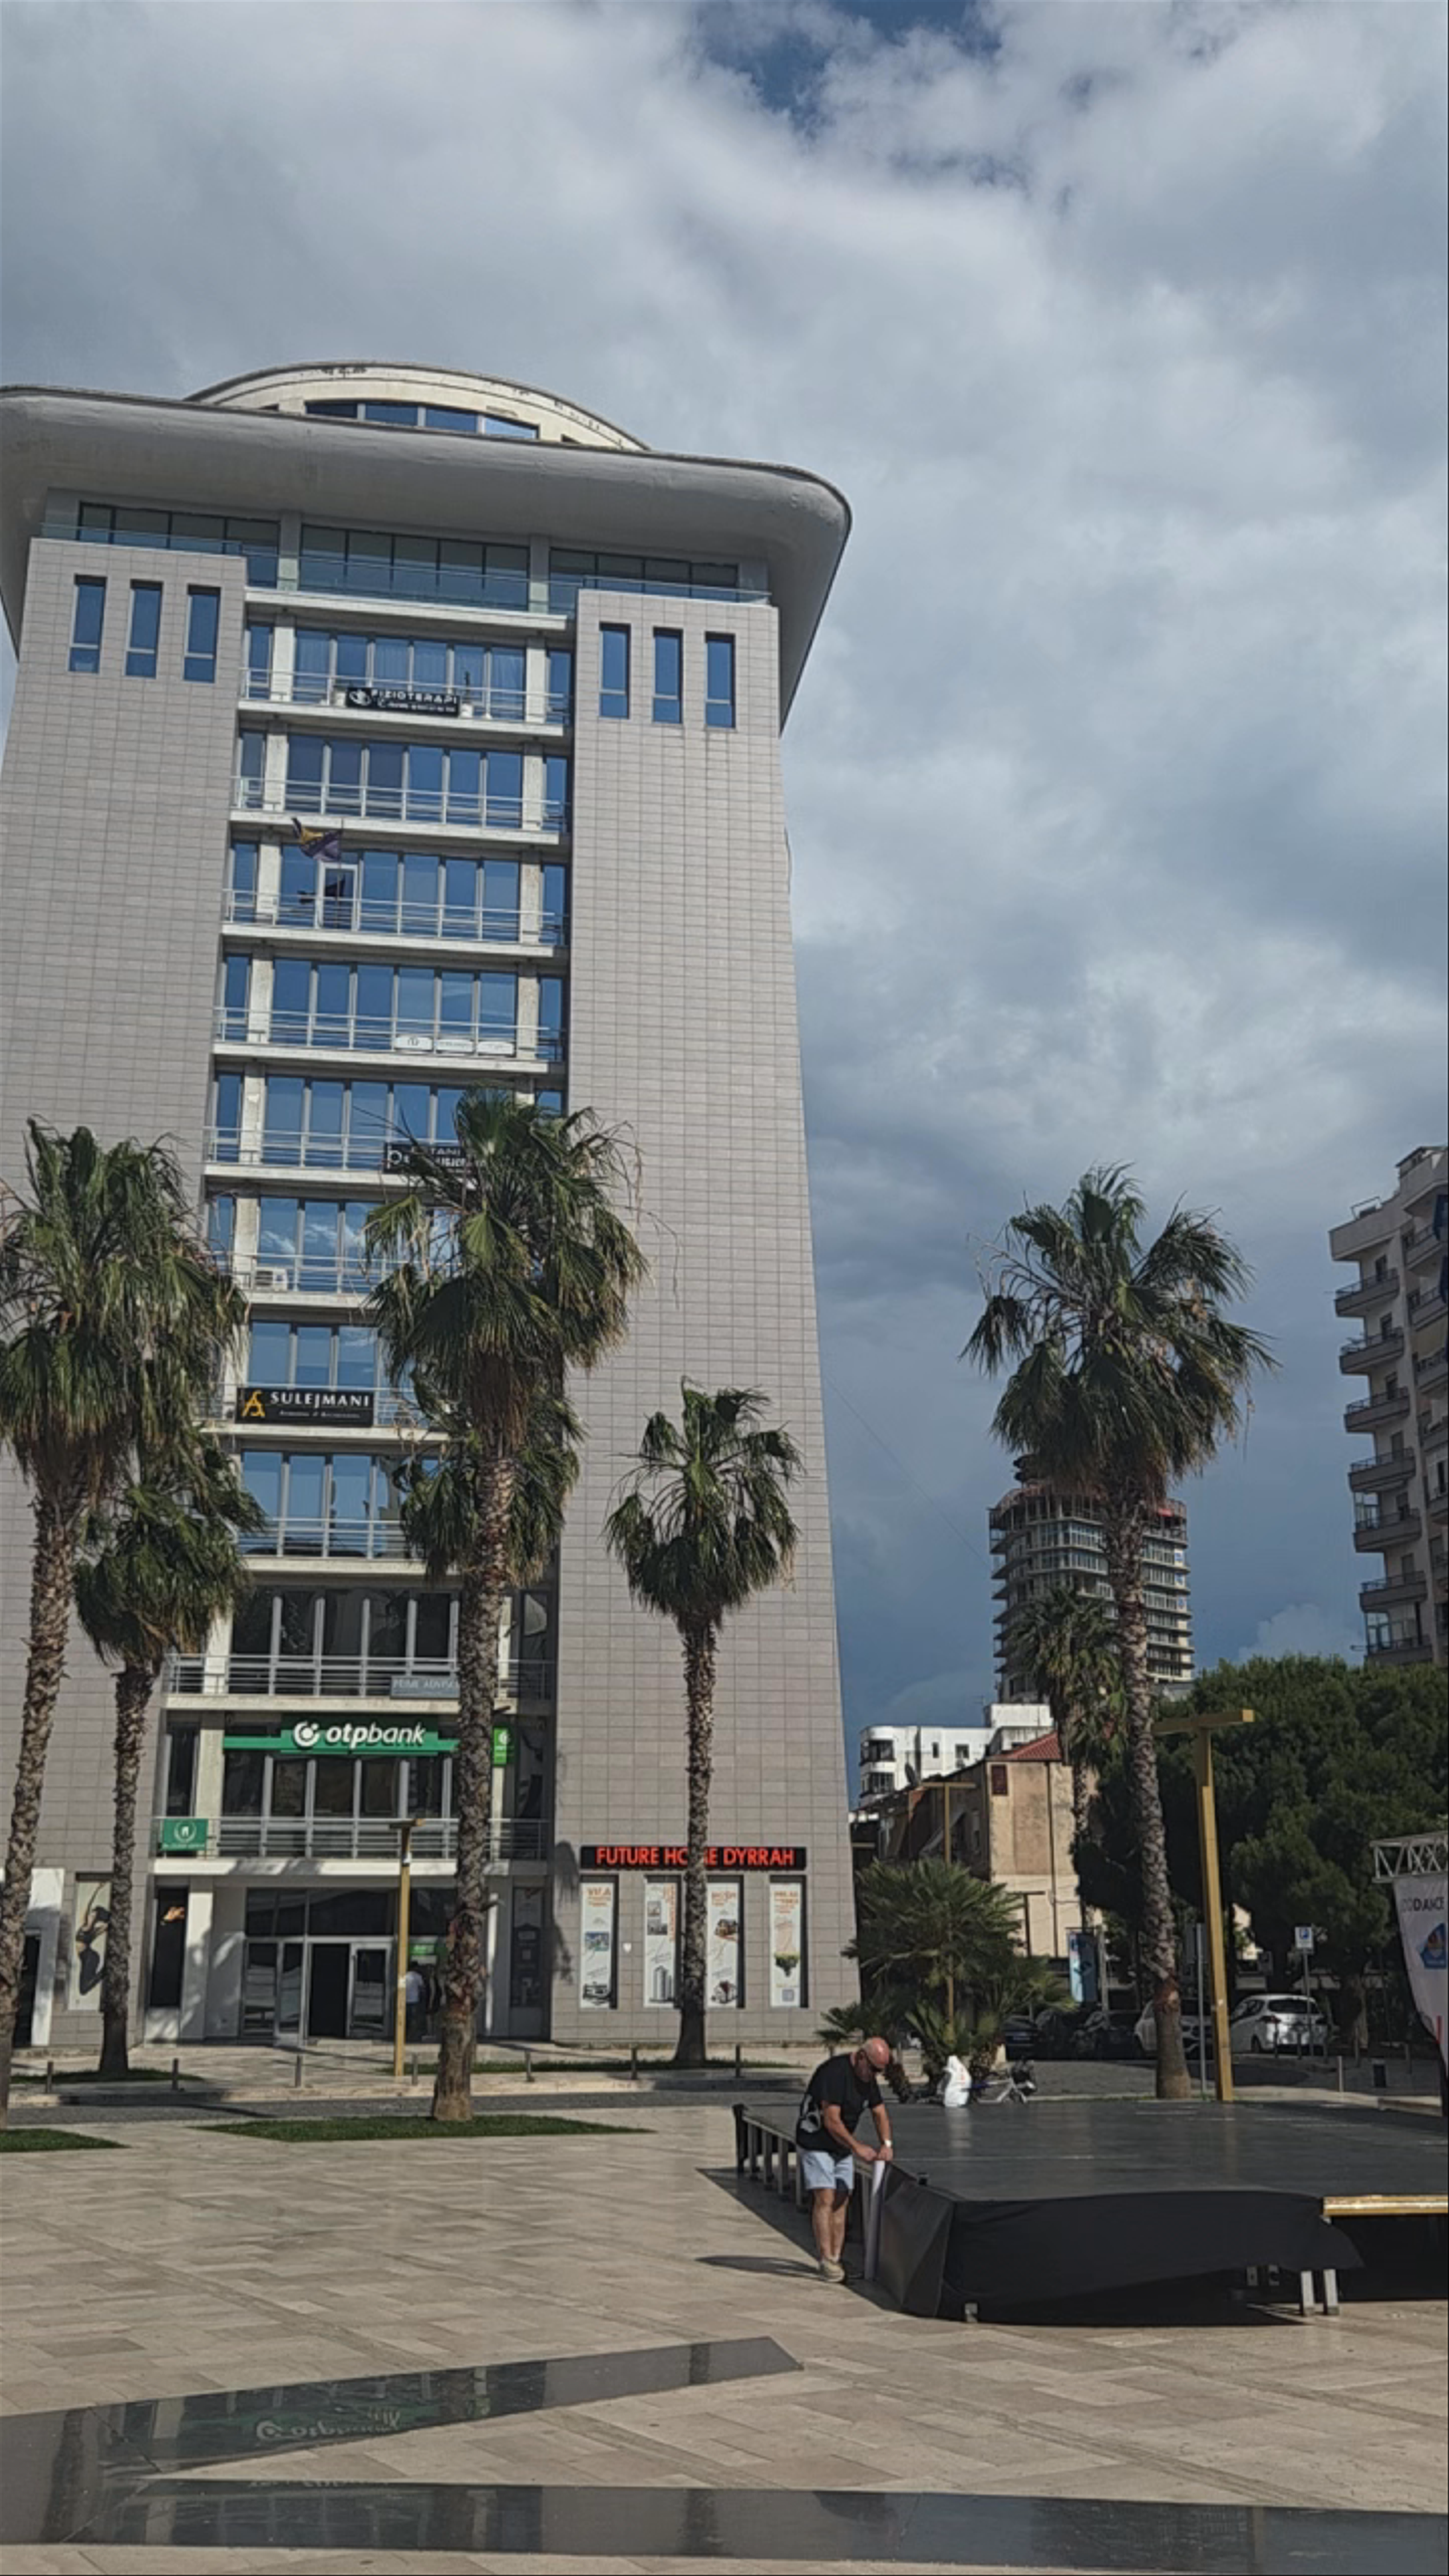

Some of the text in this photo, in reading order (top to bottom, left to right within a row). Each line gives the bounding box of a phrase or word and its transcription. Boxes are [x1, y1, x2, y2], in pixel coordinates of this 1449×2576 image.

[371, 689, 457, 704] FIZIOTERAPI
[270, 1391, 369, 1408] SULEJMANI
[326, 1722, 425, 1749] otpbank
[596, 1847, 794, 1865] FUTURE HOE DYRRAH
